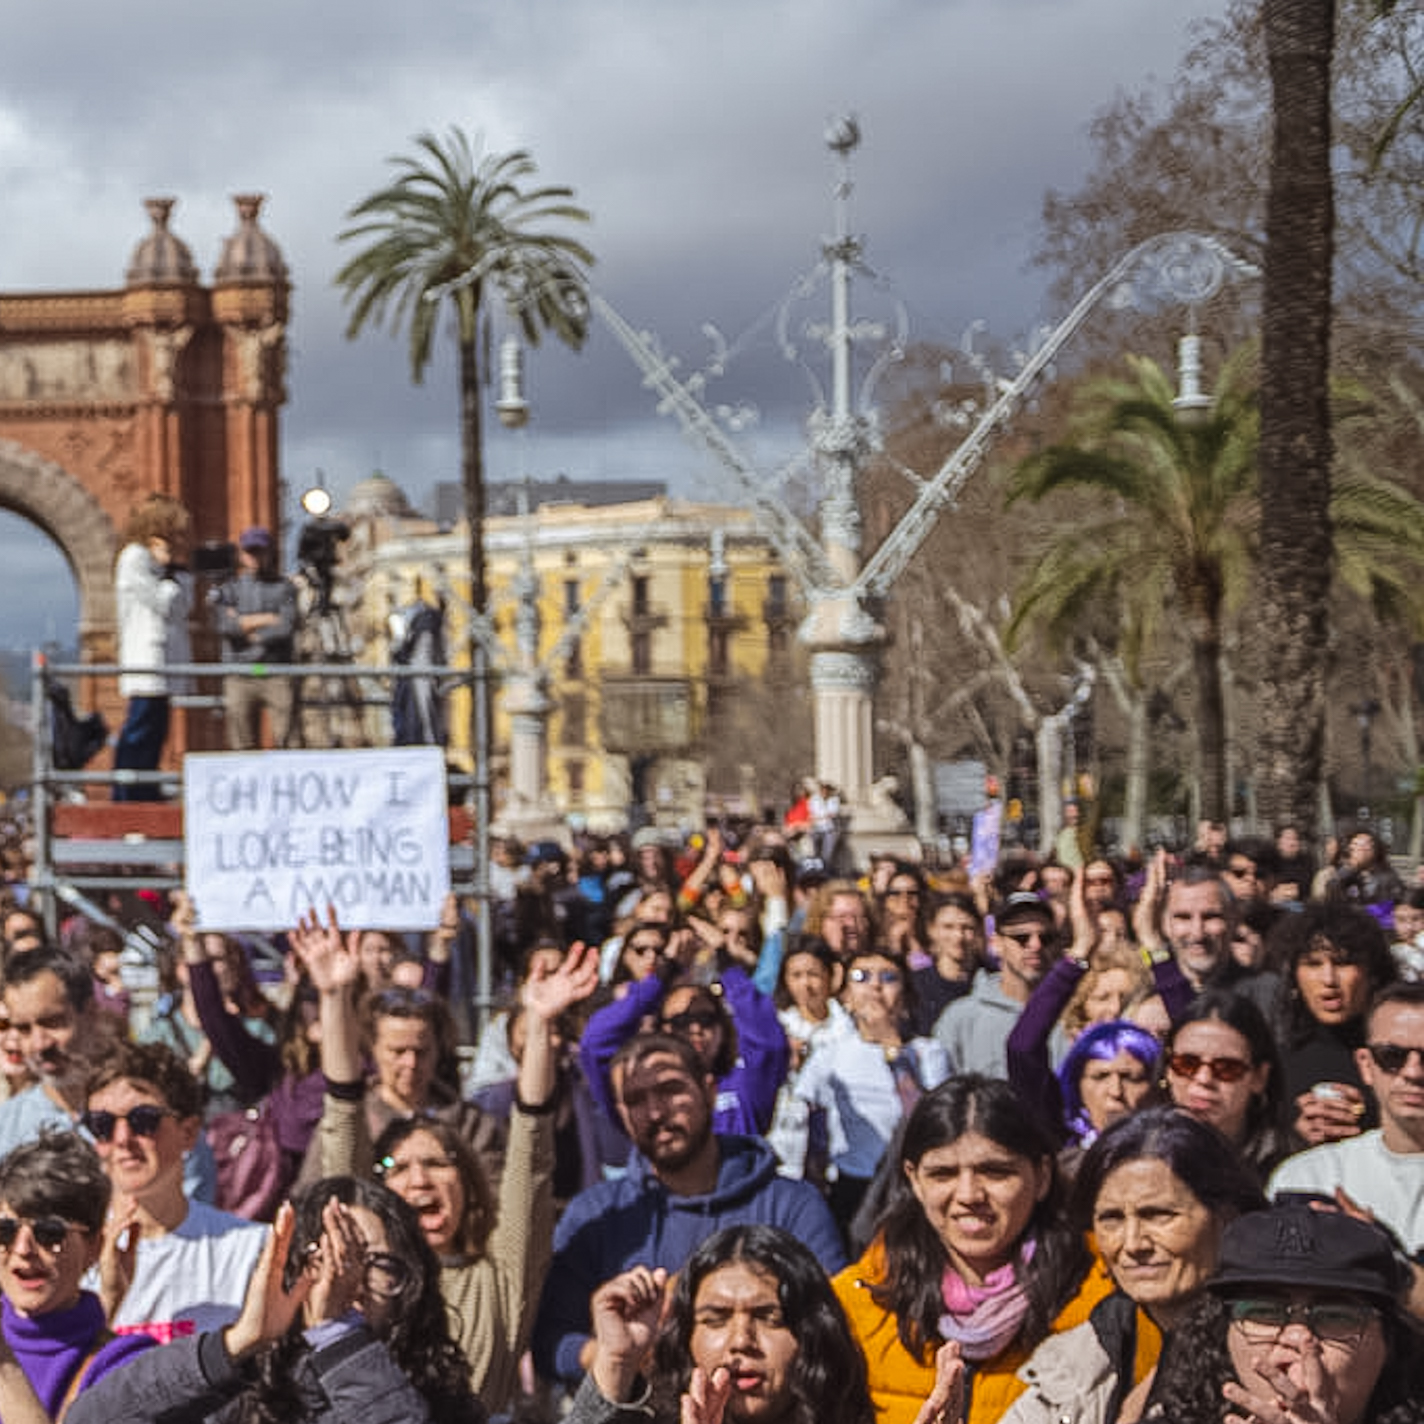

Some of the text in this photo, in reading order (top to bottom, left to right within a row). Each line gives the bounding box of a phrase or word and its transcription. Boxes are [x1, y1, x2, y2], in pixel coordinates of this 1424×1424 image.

[207, 773, 258, 815] OH
[272, 771, 360, 815] HOW
[215, 826, 423, 871] LOVE BEING
[244, 871, 432, 908] A WOMAN
